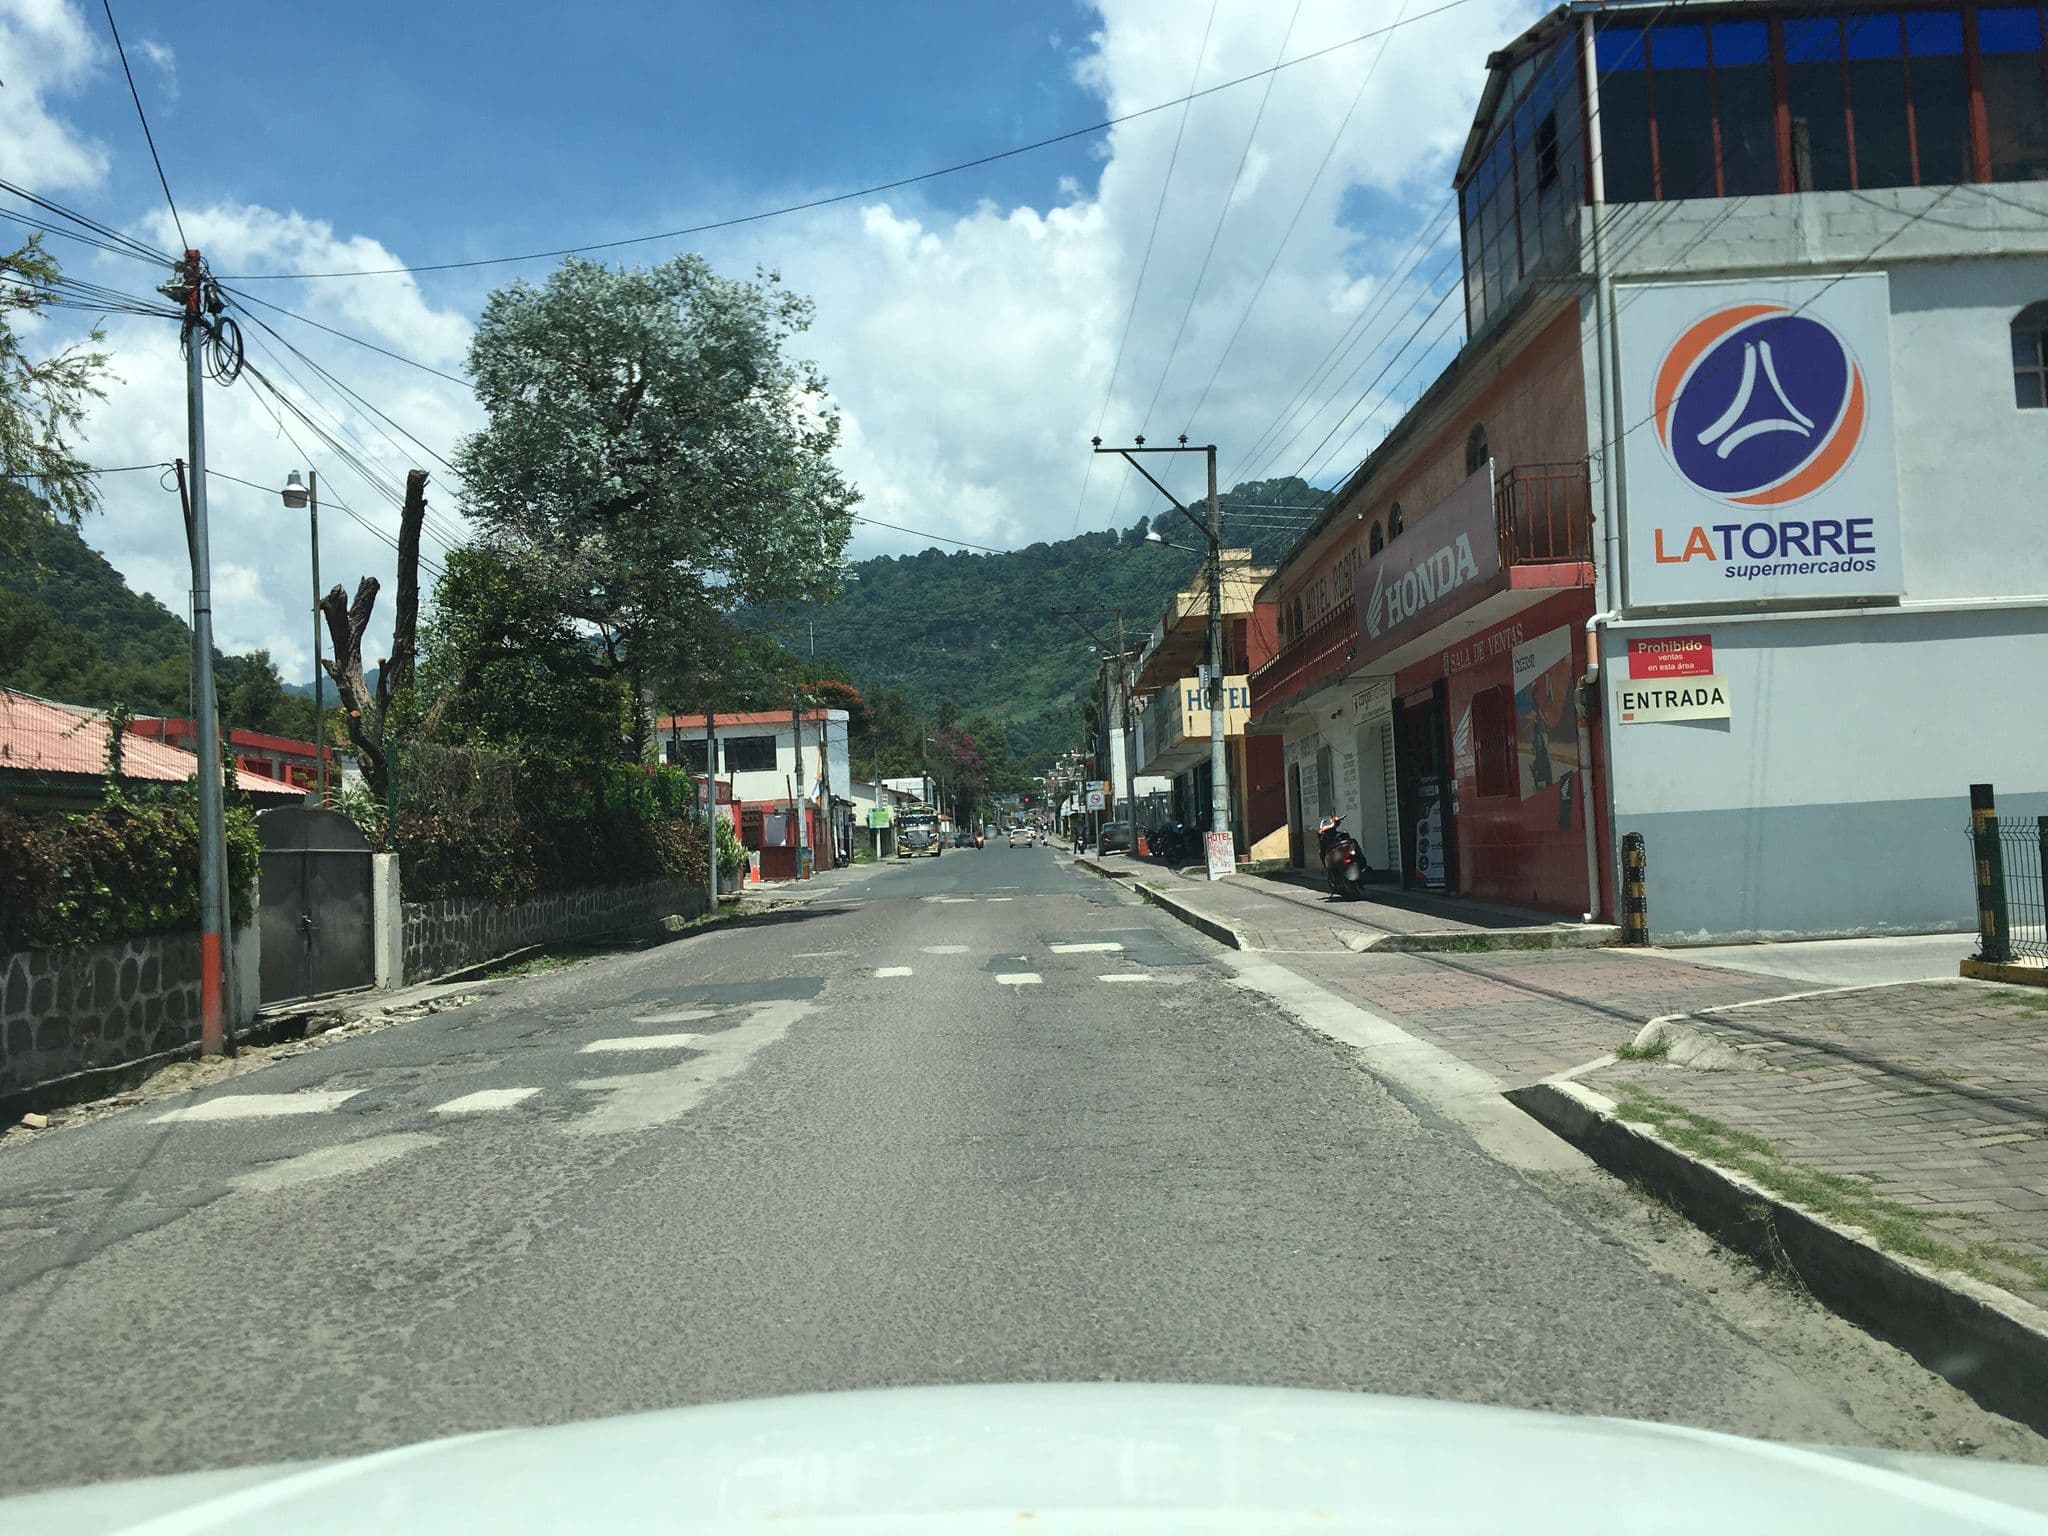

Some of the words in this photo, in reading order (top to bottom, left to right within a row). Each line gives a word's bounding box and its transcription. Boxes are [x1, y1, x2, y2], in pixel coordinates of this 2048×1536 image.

[1385, 532, 1479, 629] HONDA
[1724, 557, 1876, 581] supermercados
[1450, 647, 1471, 673] SALA
[1473, 641, 1485, 664] DE
[1487, 623, 1524, 656] VENTAS
[1638, 640, 1703, 654] Prohibido
[1648, 664, 1658, 672] en
[1660, 663, 1676, 671] esta
[1623, 687, 1725, 710] ENTRADA
[1208, 832, 1232, 842] HOTEL
